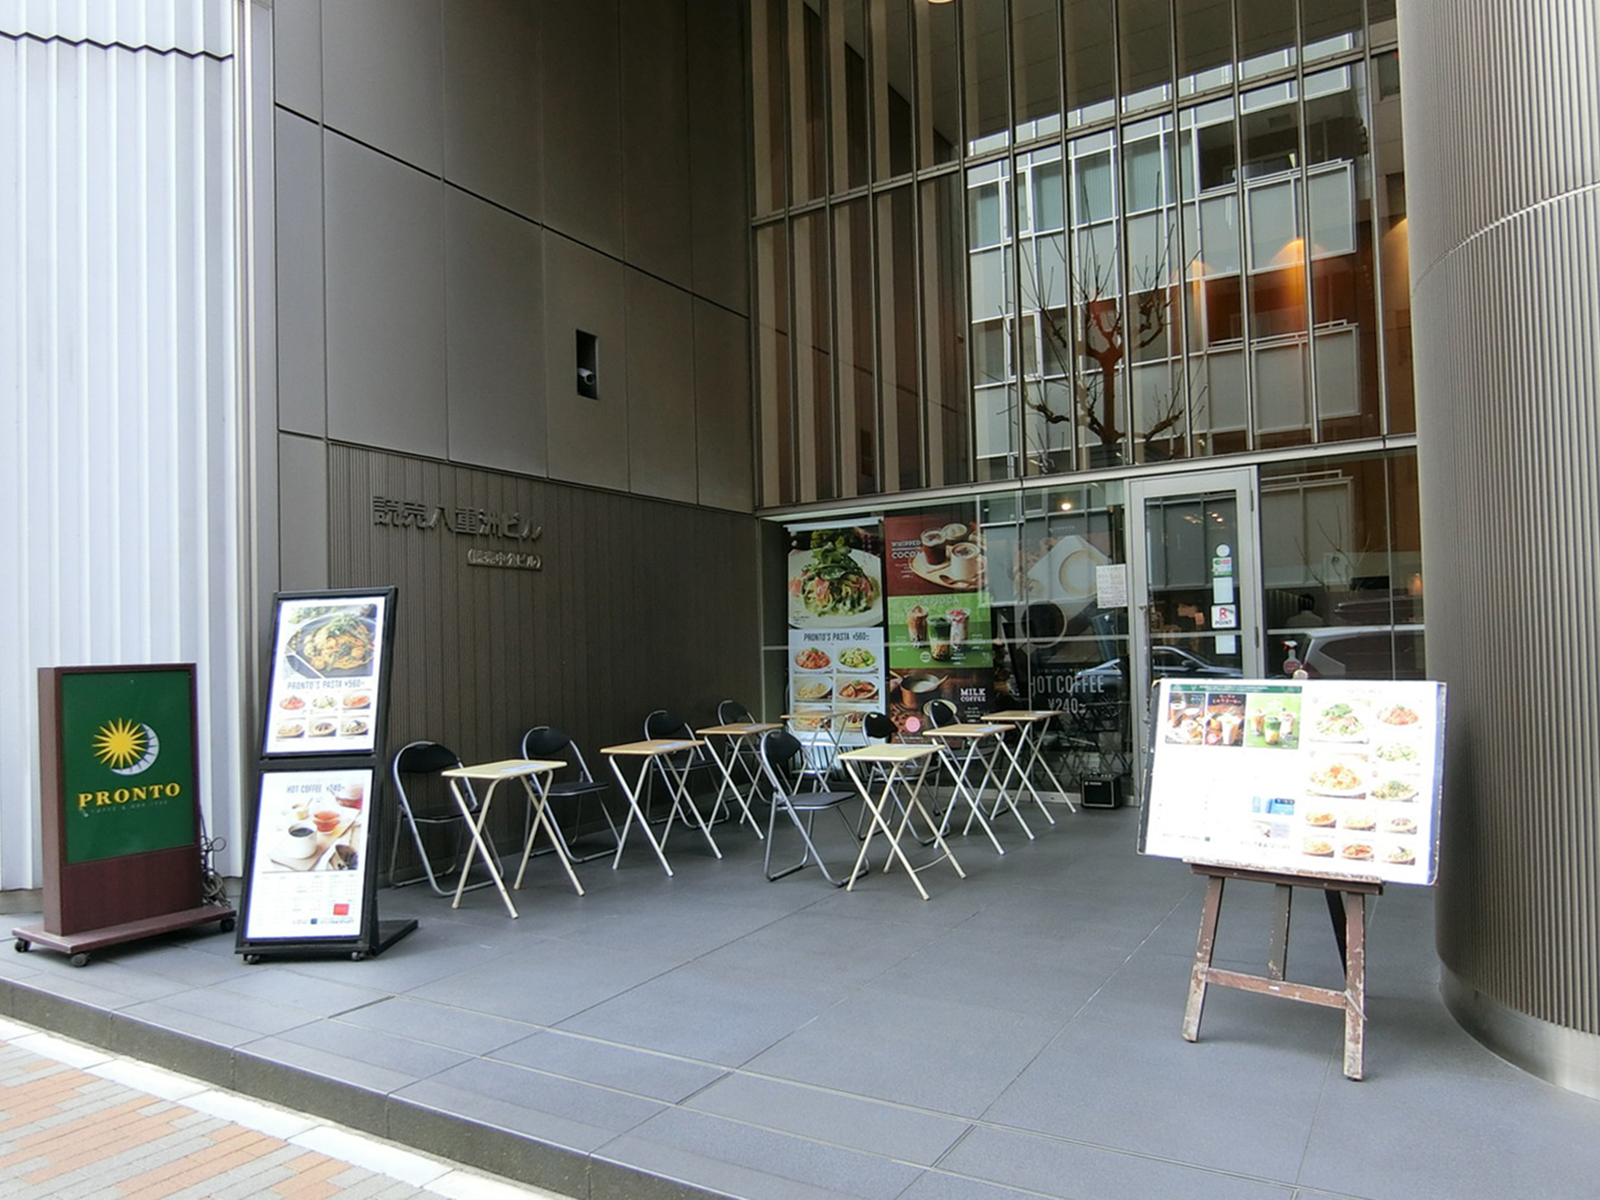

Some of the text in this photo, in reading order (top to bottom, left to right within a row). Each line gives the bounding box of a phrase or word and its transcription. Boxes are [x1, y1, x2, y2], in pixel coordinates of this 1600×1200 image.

[373, 496, 542, 541] 読売八重洲ビル
[803, 632, 832, 641] PRONTO'S
[833, 632, 850, 641] PASTA
[287, 680, 321, 690] PRONTO'S
[322, 680, 343, 689] PASTA
[1029, 674, 1105, 694] HOT COFFEE
[960, 688, 986, 696] MILK
[960, 695, 986, 703] COFFEE
[286, 785, 299, 794] HOT
[300, 784, 323, 793] COFFEE
[78, 782, 181, 808] PRONTO
